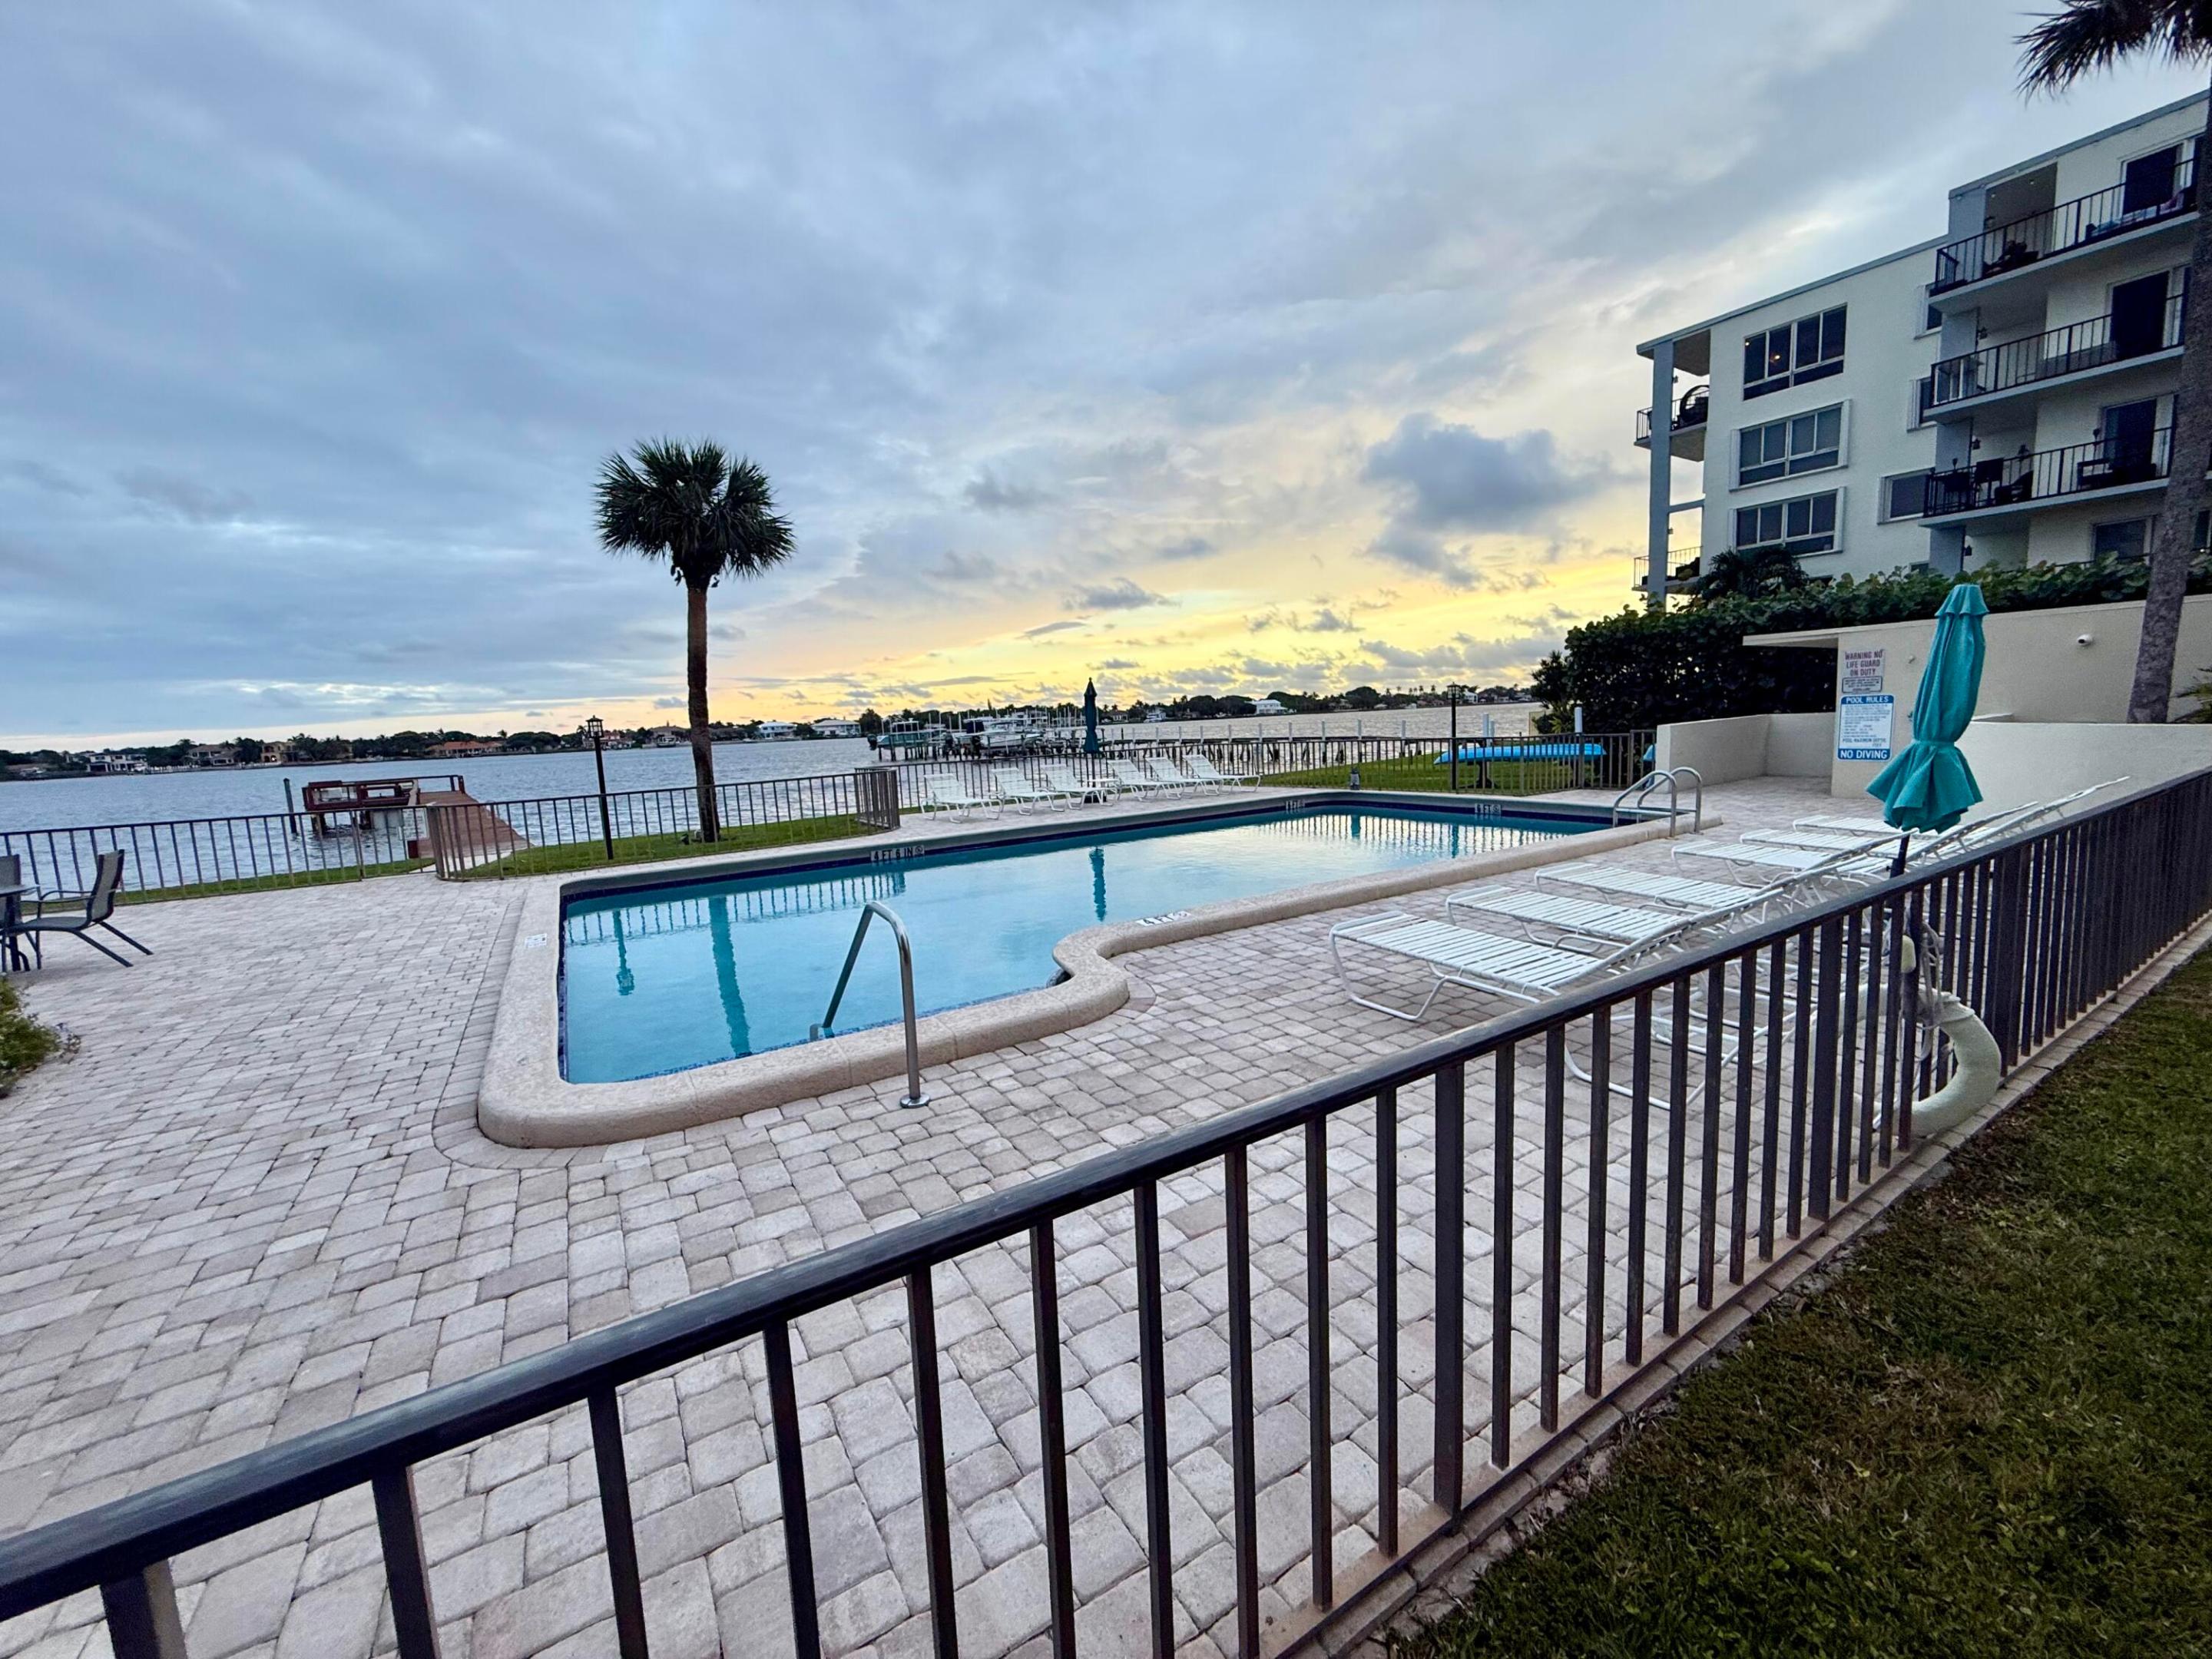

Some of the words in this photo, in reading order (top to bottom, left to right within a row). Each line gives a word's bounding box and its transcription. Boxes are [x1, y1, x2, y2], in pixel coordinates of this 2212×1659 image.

[1845, 651, 1873, 660] WARNING
[1874, 649, 1883, 658] NO
[1860, 659, 1881, 667] GUARD
[1840, 750, 1853, 759] NO
[1856, 750, 1888, 759] DIVING
[874, 851, 879, 860] 4
[882, 849, 892, 860] FT
[896, 848, 901, 860] 6
[904, 846, 913, 858] IN
